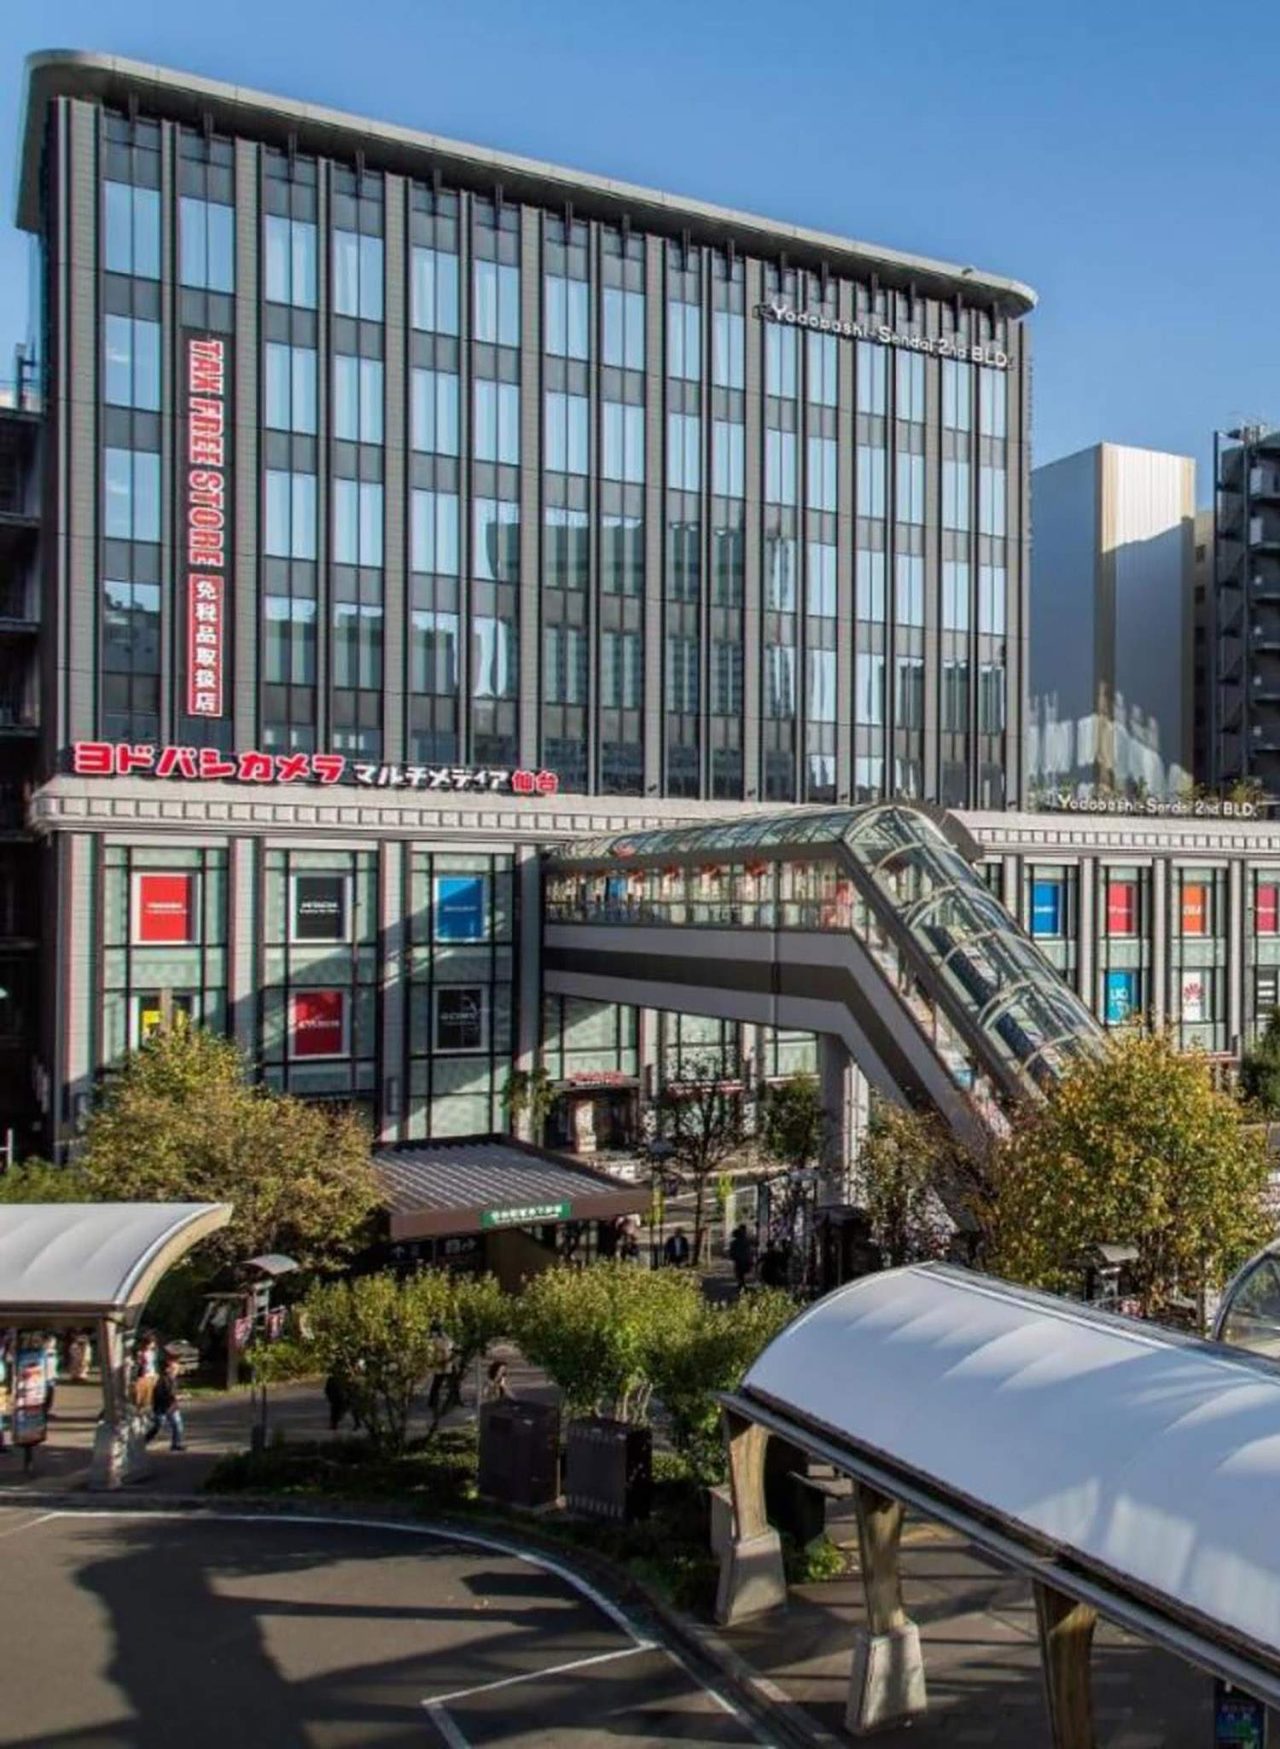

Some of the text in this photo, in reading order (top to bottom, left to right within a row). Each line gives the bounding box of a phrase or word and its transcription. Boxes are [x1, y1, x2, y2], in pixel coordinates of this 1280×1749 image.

[190, 338, 225, 567] TAX FREE STORE
[74, 740, 346, 784] ヨドバシカメラ
